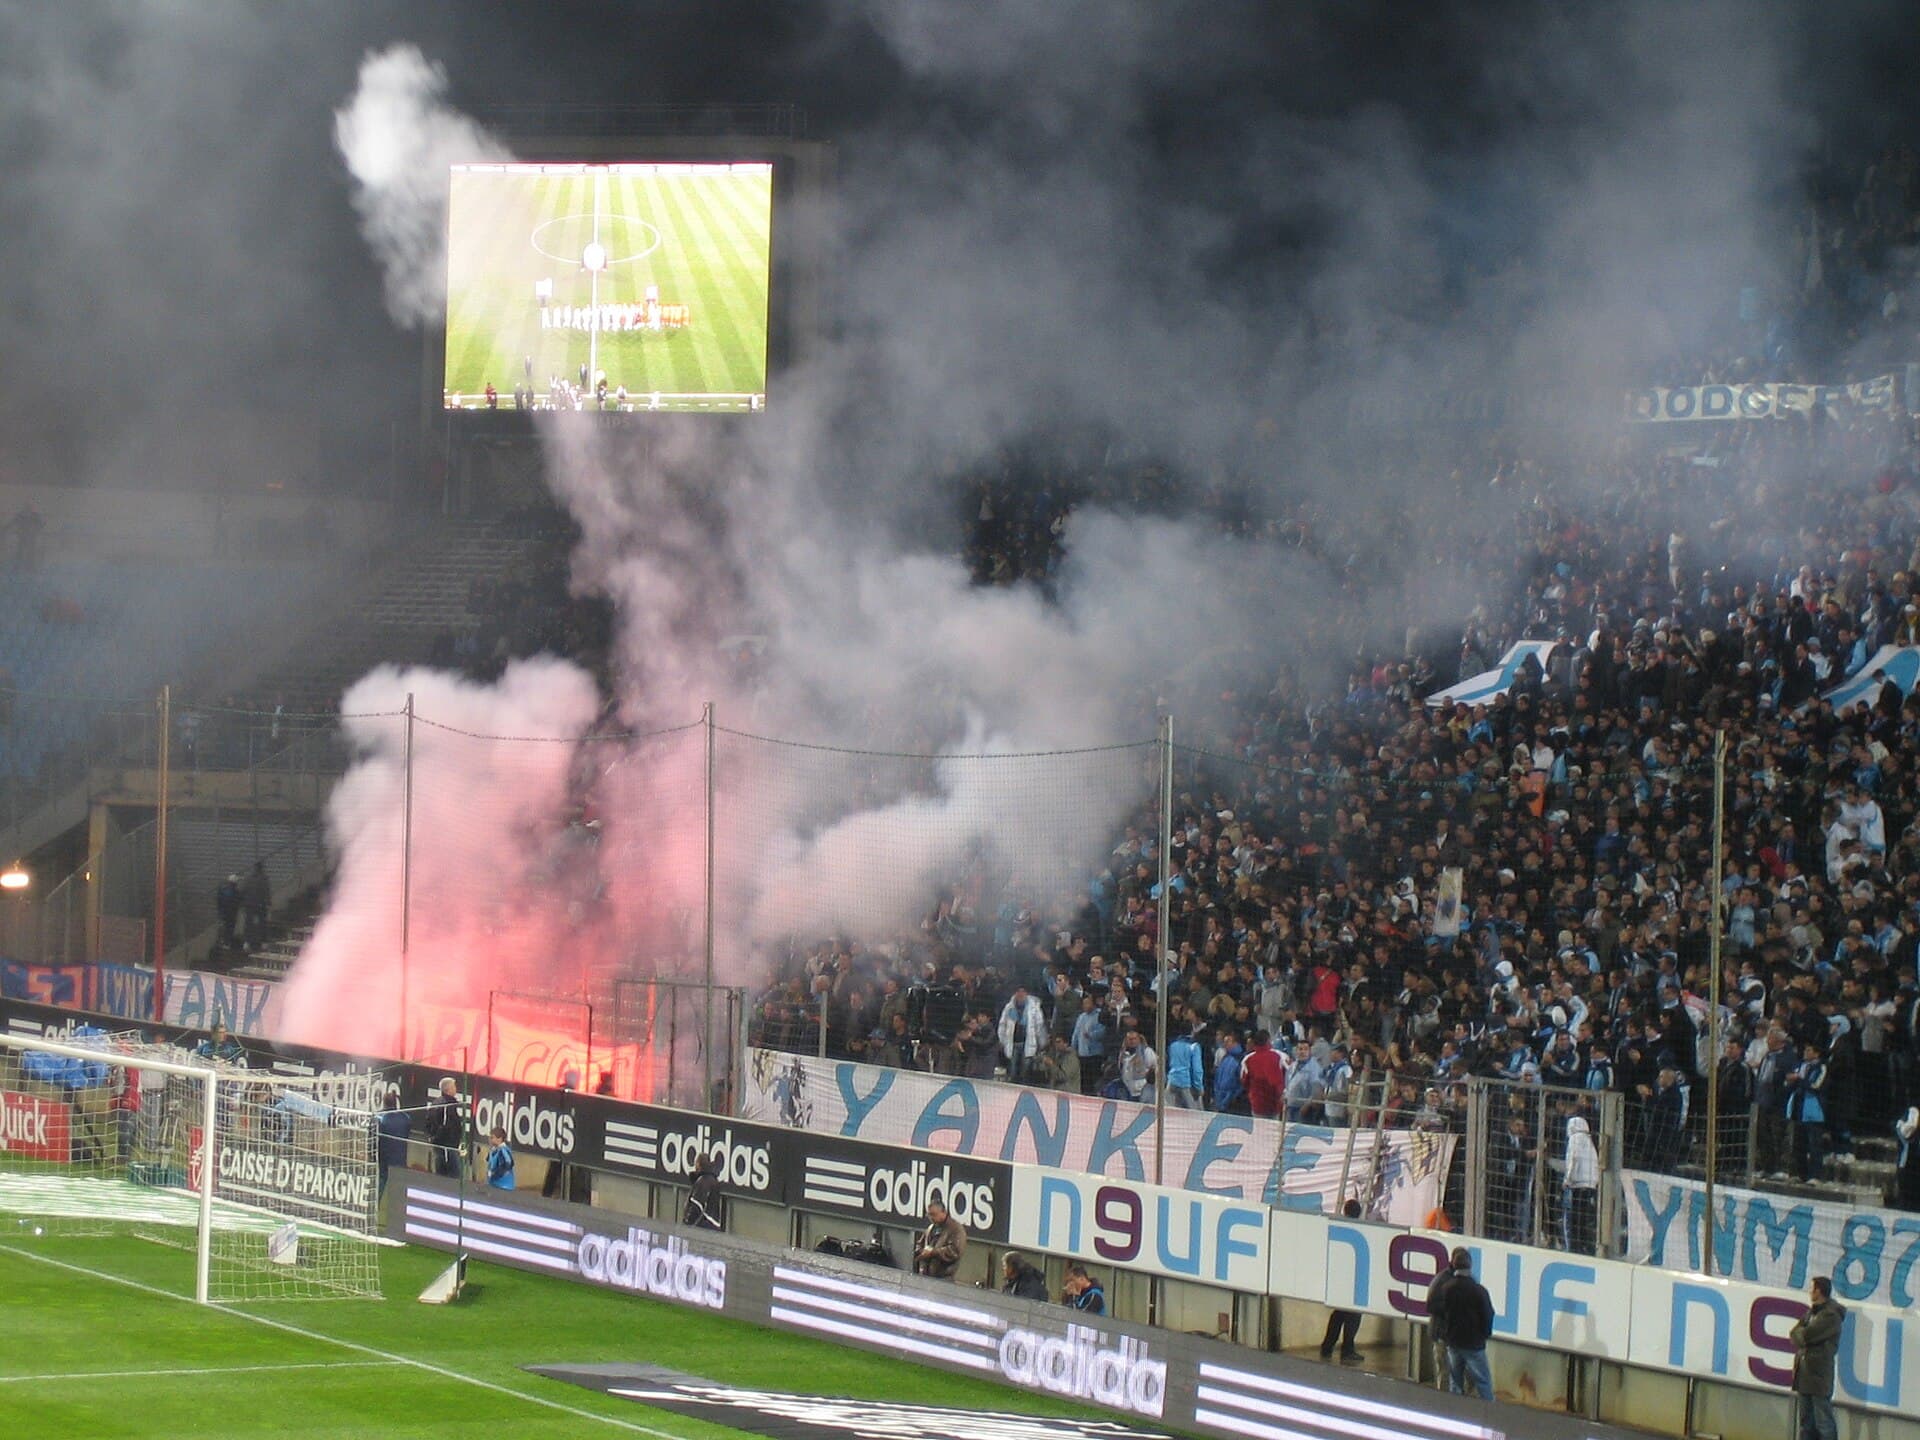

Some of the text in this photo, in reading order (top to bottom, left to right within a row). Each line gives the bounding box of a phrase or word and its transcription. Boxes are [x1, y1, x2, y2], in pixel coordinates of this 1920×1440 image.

[476, 1091, 576, 1154] adidas
[661, 1125, 770, 1190] adidas
[836, 1063, 1334, 1214] YANKEE
[219, 1147, 371, 1208] CAISSE D'EPARGNE
[870, 1160, 995, 1230] adidas
[577, 1227, 727, 1310] adidas
[1634, 1179, 1813, 1288] YNM
